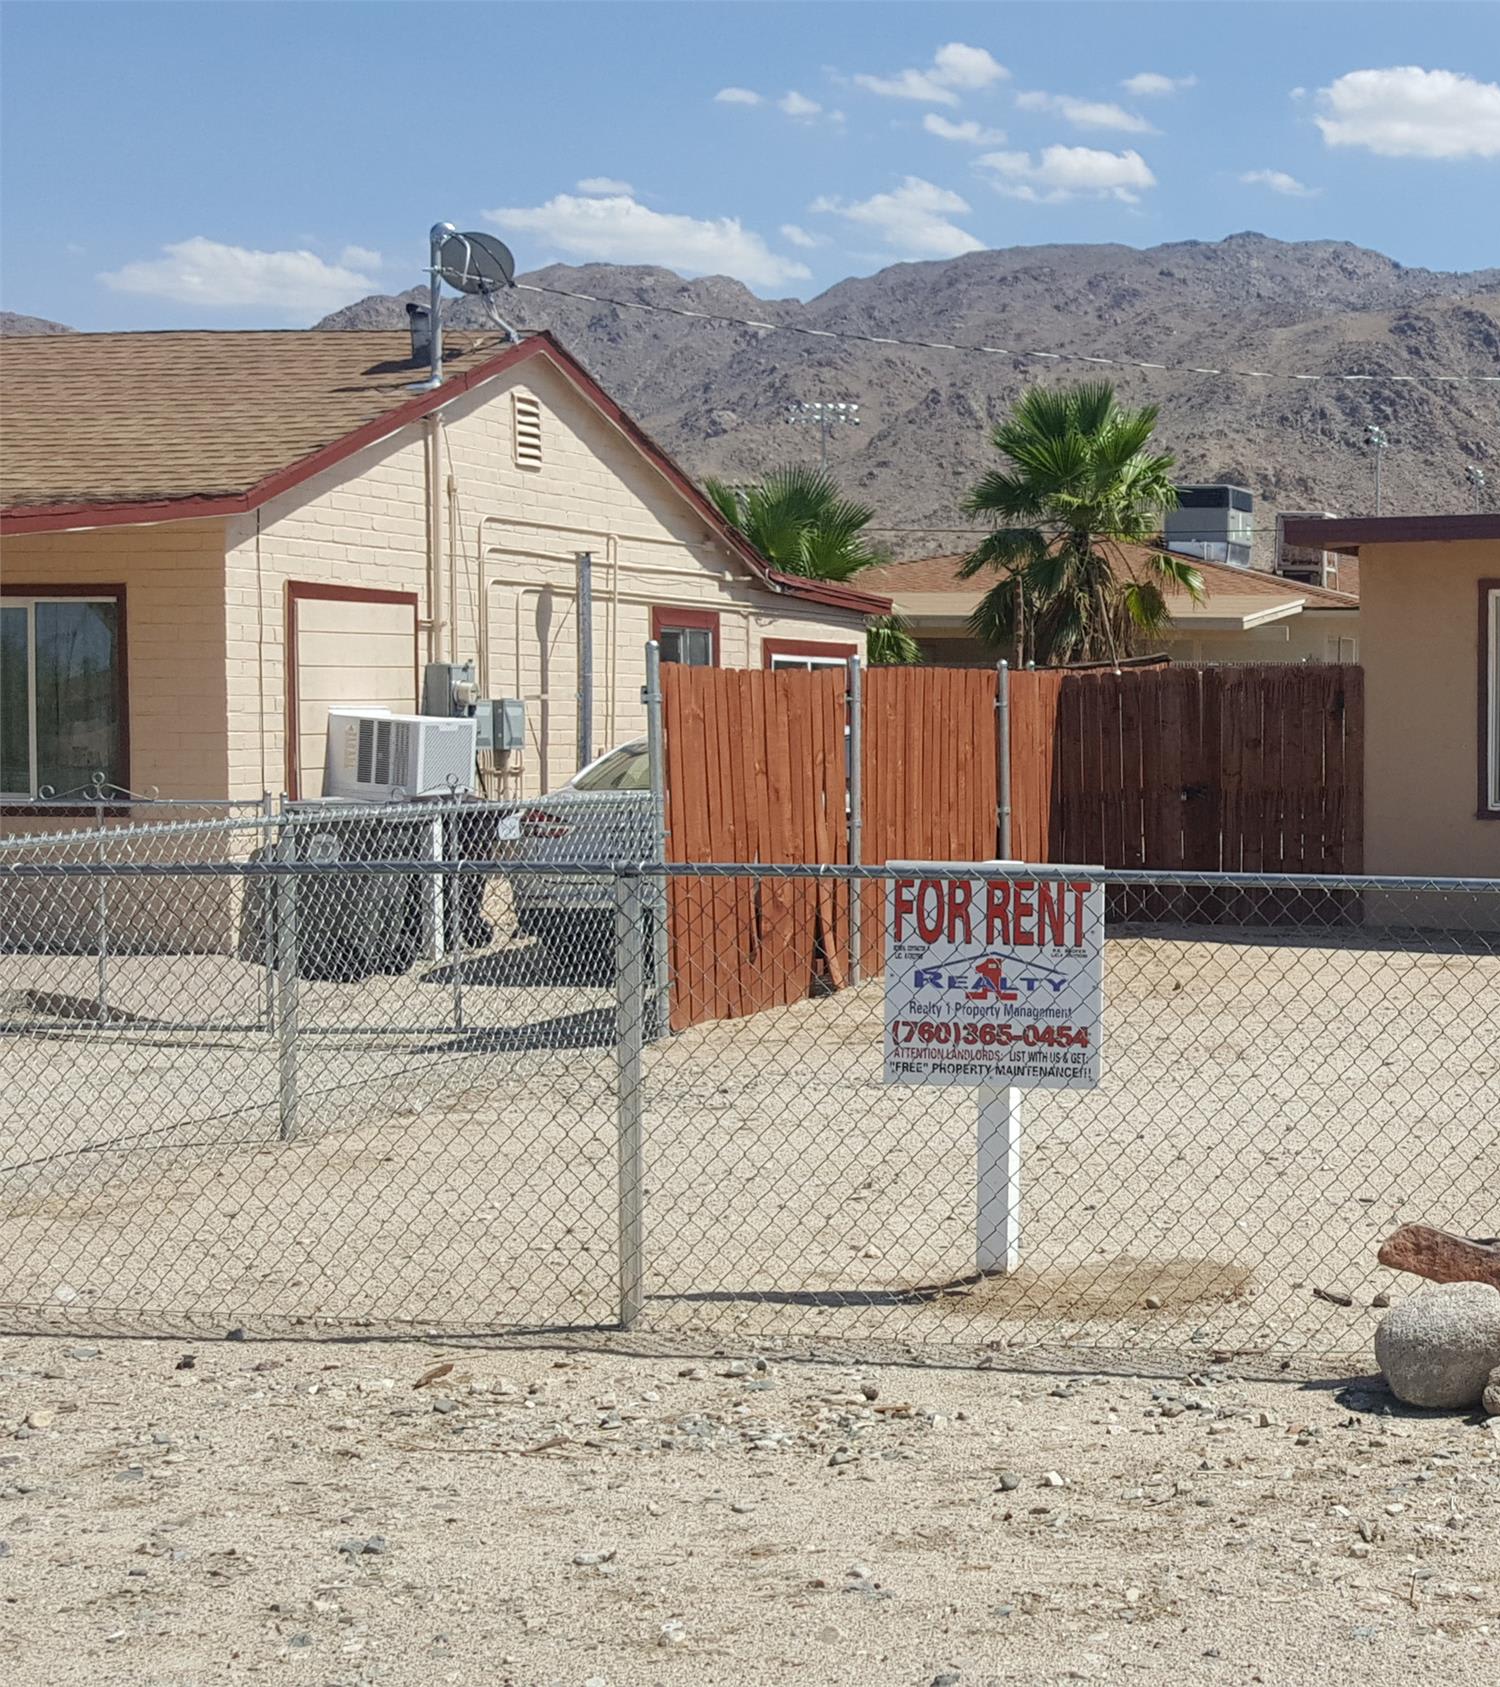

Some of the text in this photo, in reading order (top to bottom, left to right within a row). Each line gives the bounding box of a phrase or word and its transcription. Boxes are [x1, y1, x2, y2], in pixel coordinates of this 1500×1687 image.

[893, 878, 1091, 948] FOR RENT
[914, 970, 1068, 992] REALTY
[909, 1001, 942, 1018] Realty
[955, 1003, 1000, 1020] Property
[1003, 1004, 1072, 1020] Management
[892, 1020, 1089, 1049] (760)365-0454
[1009, 1050, 1025, 1062] LIST
[1027, 1051, 1048, 1063] WITH
[1050, 1052, 1061, 1063] US
[890, 1061, 929, 1073] "FREE"
[931, 1062, 992, 1075] PROPERTY
